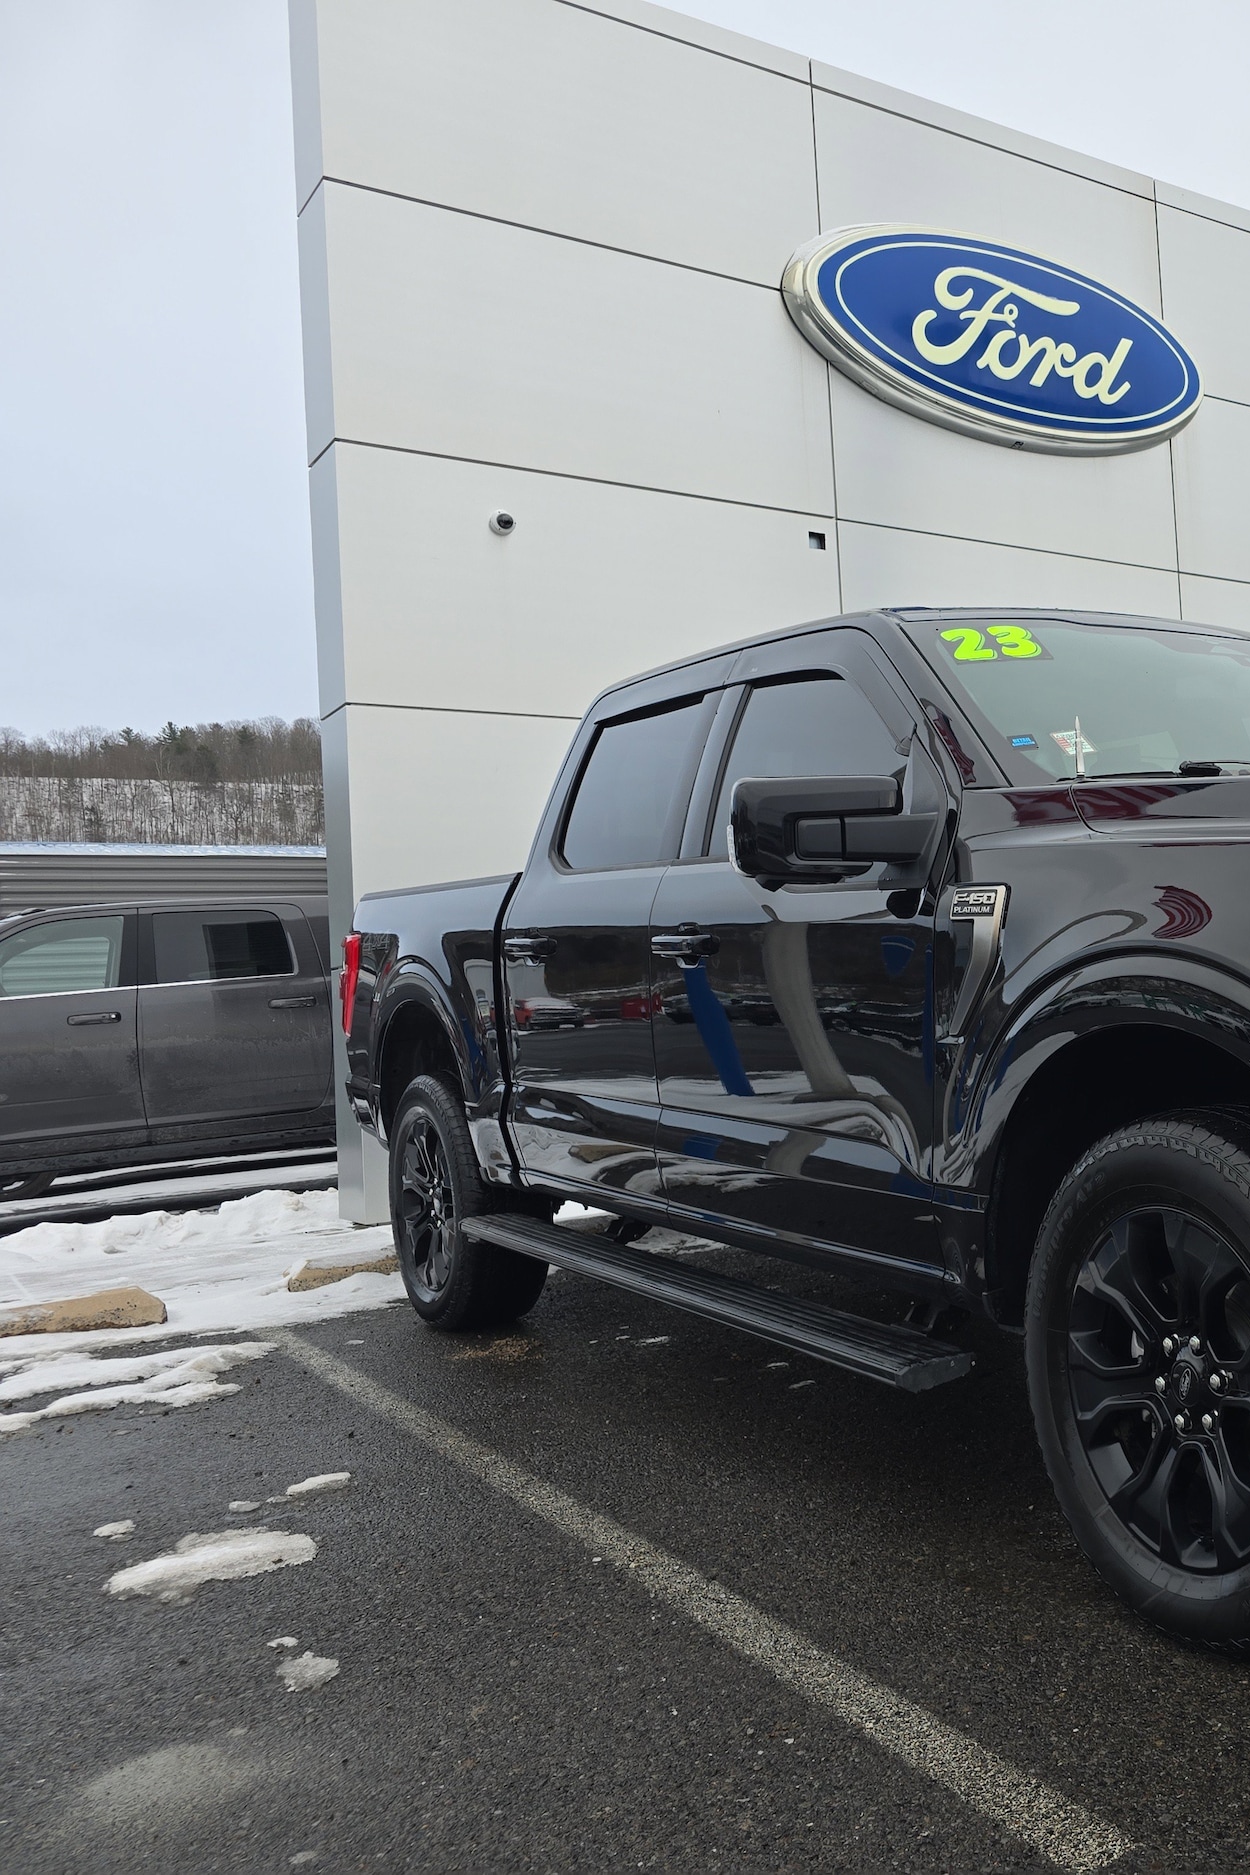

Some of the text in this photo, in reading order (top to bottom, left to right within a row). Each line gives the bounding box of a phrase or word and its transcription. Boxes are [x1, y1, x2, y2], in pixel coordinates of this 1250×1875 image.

[912, 266, 1134, 406] Ford
[940, 625, 1042, 661] 23
[953, 892, 996, 905] F-150
[953, 906, 991, 914] PLATINUM
